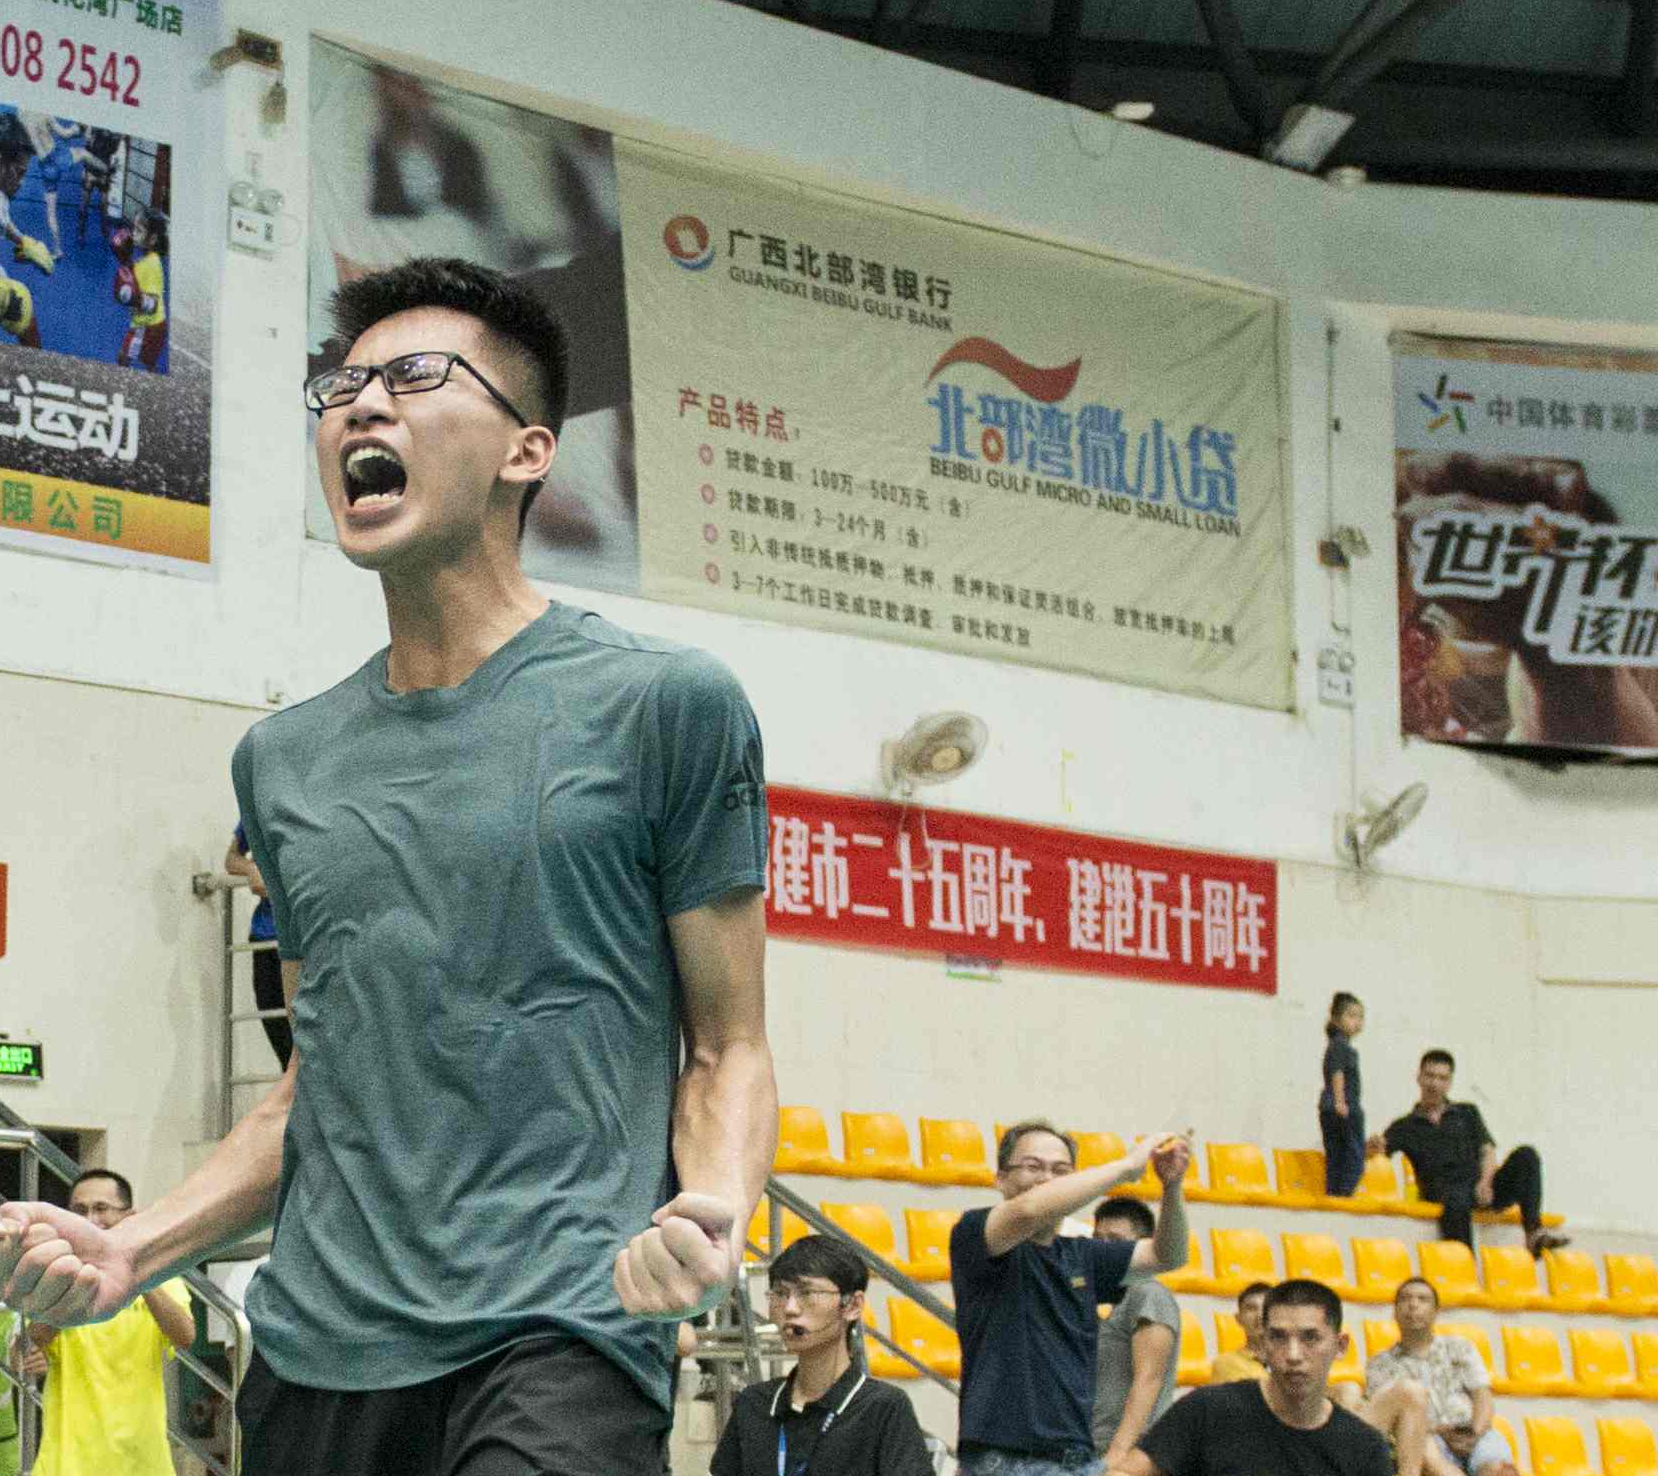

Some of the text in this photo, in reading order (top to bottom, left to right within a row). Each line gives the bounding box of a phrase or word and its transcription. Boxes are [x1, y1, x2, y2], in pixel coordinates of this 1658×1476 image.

[56, 37, 143, 108] 2542
[728, 228, 952, 310] 广西北部湾银行
[730, 265, 953, 333] GUANGXI BEIBU GULF BANK
[926, 382, 1238, 517] 北部湾微小贷
[930, 455, 1242, 538] BEIBU GULF MICRO AND SMALL LOAN
[1422, 518, 1658, 634] 世界杯
[765, 814, 1269, 973] 建市二十五周年、建港五十周年
